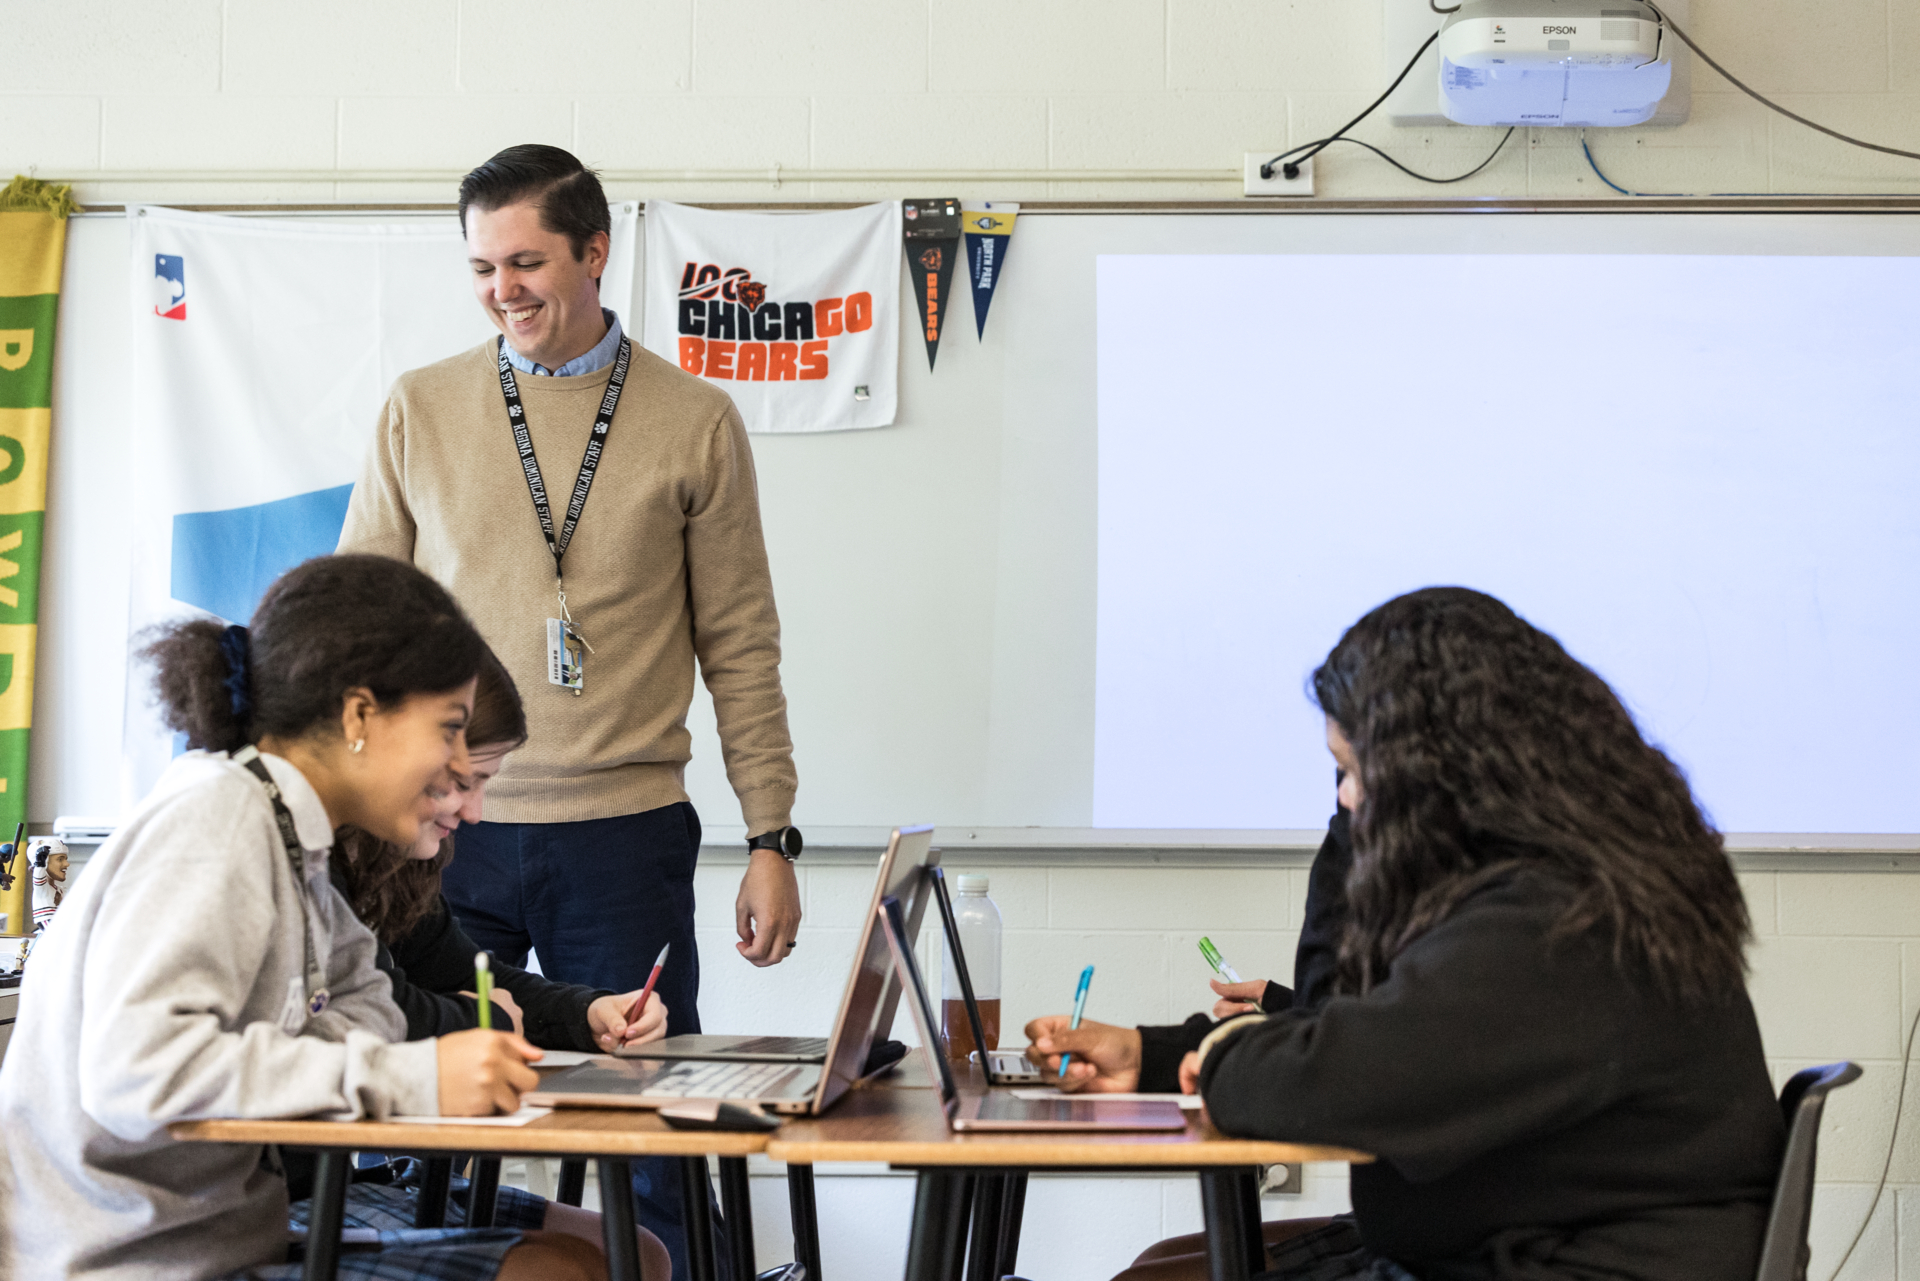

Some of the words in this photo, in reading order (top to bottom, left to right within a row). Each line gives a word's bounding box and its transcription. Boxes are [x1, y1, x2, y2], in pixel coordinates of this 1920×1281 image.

[1542, 26, 1577, 35] EPSON
[981, 237, 995, 266] NORTH
[678, 262, 752, 302] 100
[977, 267, 993, 289] PARK
[678, 291, 873, 341] CHICAGO
[926, 272, 938, 342] BEARS
[600, 384, 621, 416] REGINA
[611, 340, 630, 385] DOMINICAN
[678, 336, 829, 382] BEARS
[500, 371, 518, 398] STAFF
[512, 423, 533, 457] REGINA
[522, 456, 547, 505] DOMINICAN
[568, 468, 594, 519] DOMINICAN
[584, 440, 603, 468] STAFF
[537, 506, 554, 535] STAFF
